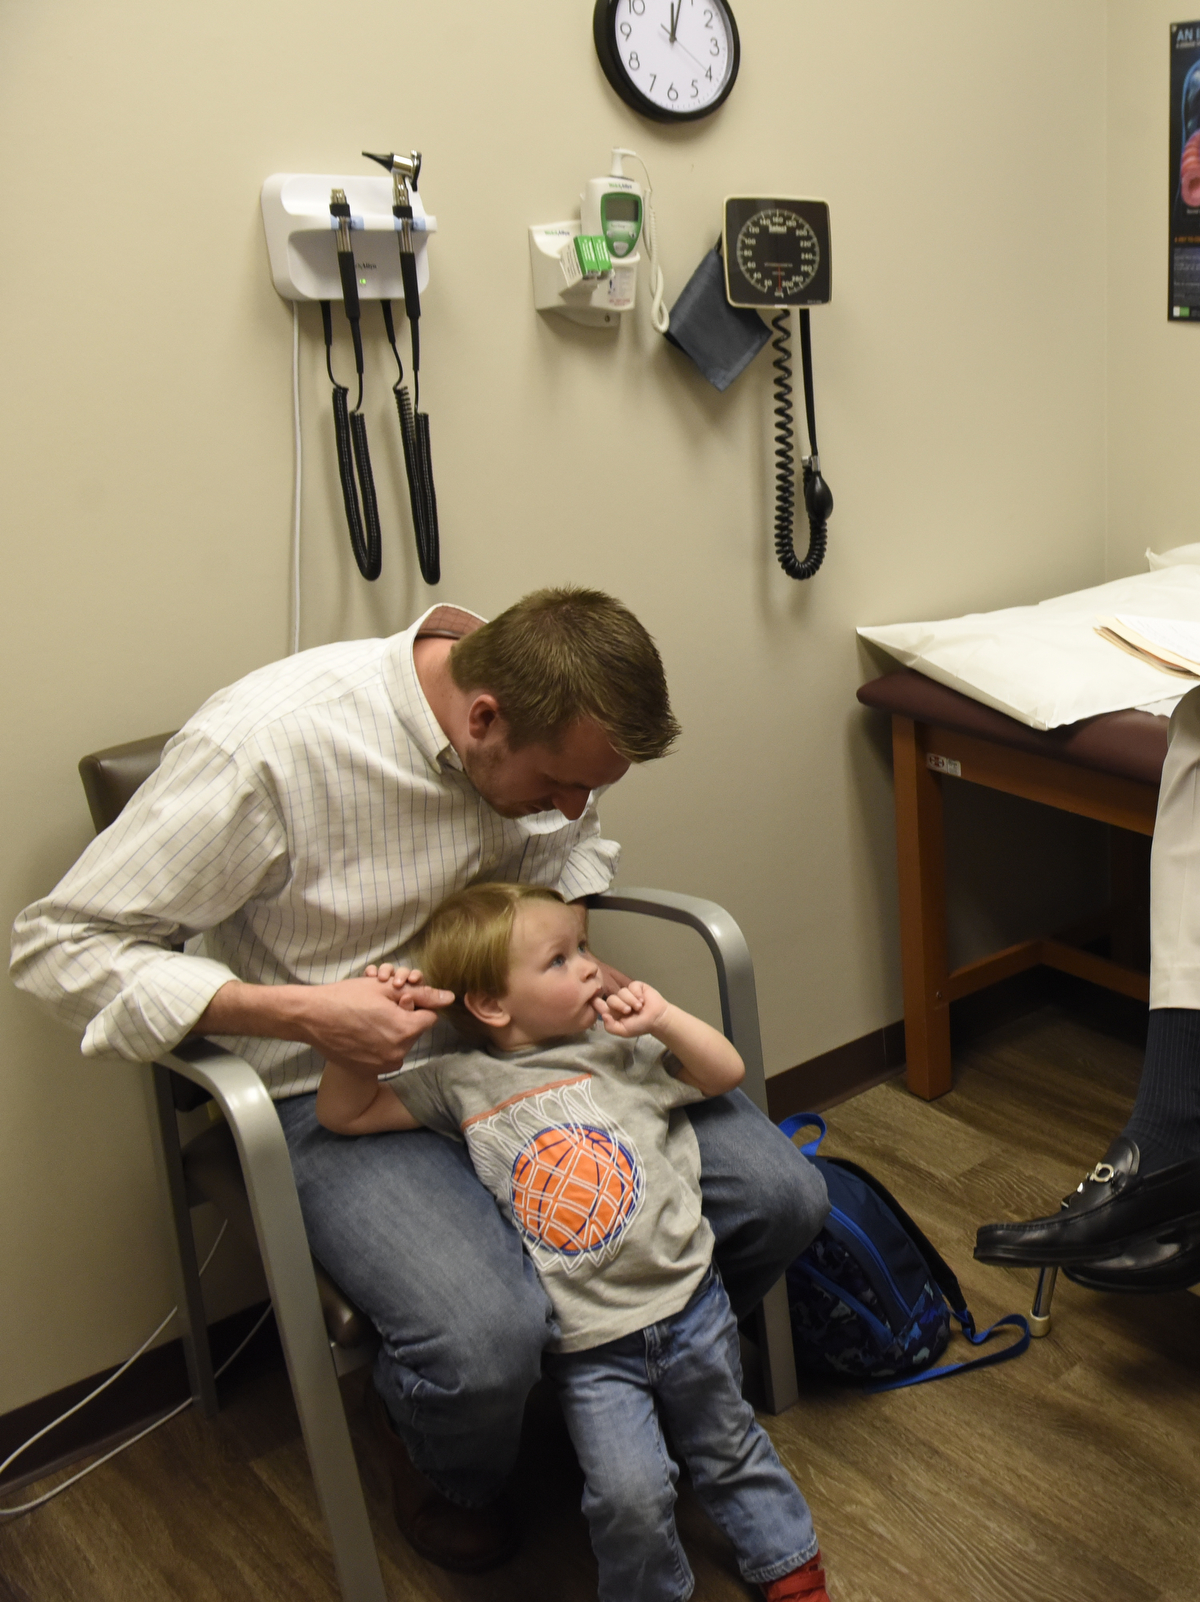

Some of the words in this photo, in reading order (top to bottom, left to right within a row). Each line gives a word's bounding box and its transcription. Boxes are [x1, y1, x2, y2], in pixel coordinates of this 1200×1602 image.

[703, 9, 713, 29] 2
[620, 22, 632, 42] 9
[1176, 26, 1193, 41] AN
[709, 37, 720, 56] 3
[628, 51, 640, 71] 8
[649, 73, 657, 92] 7
[705, 64, 713, 82] 4
[667, 82, 679, 101] 6
[690, 80, 699, 98] 5
